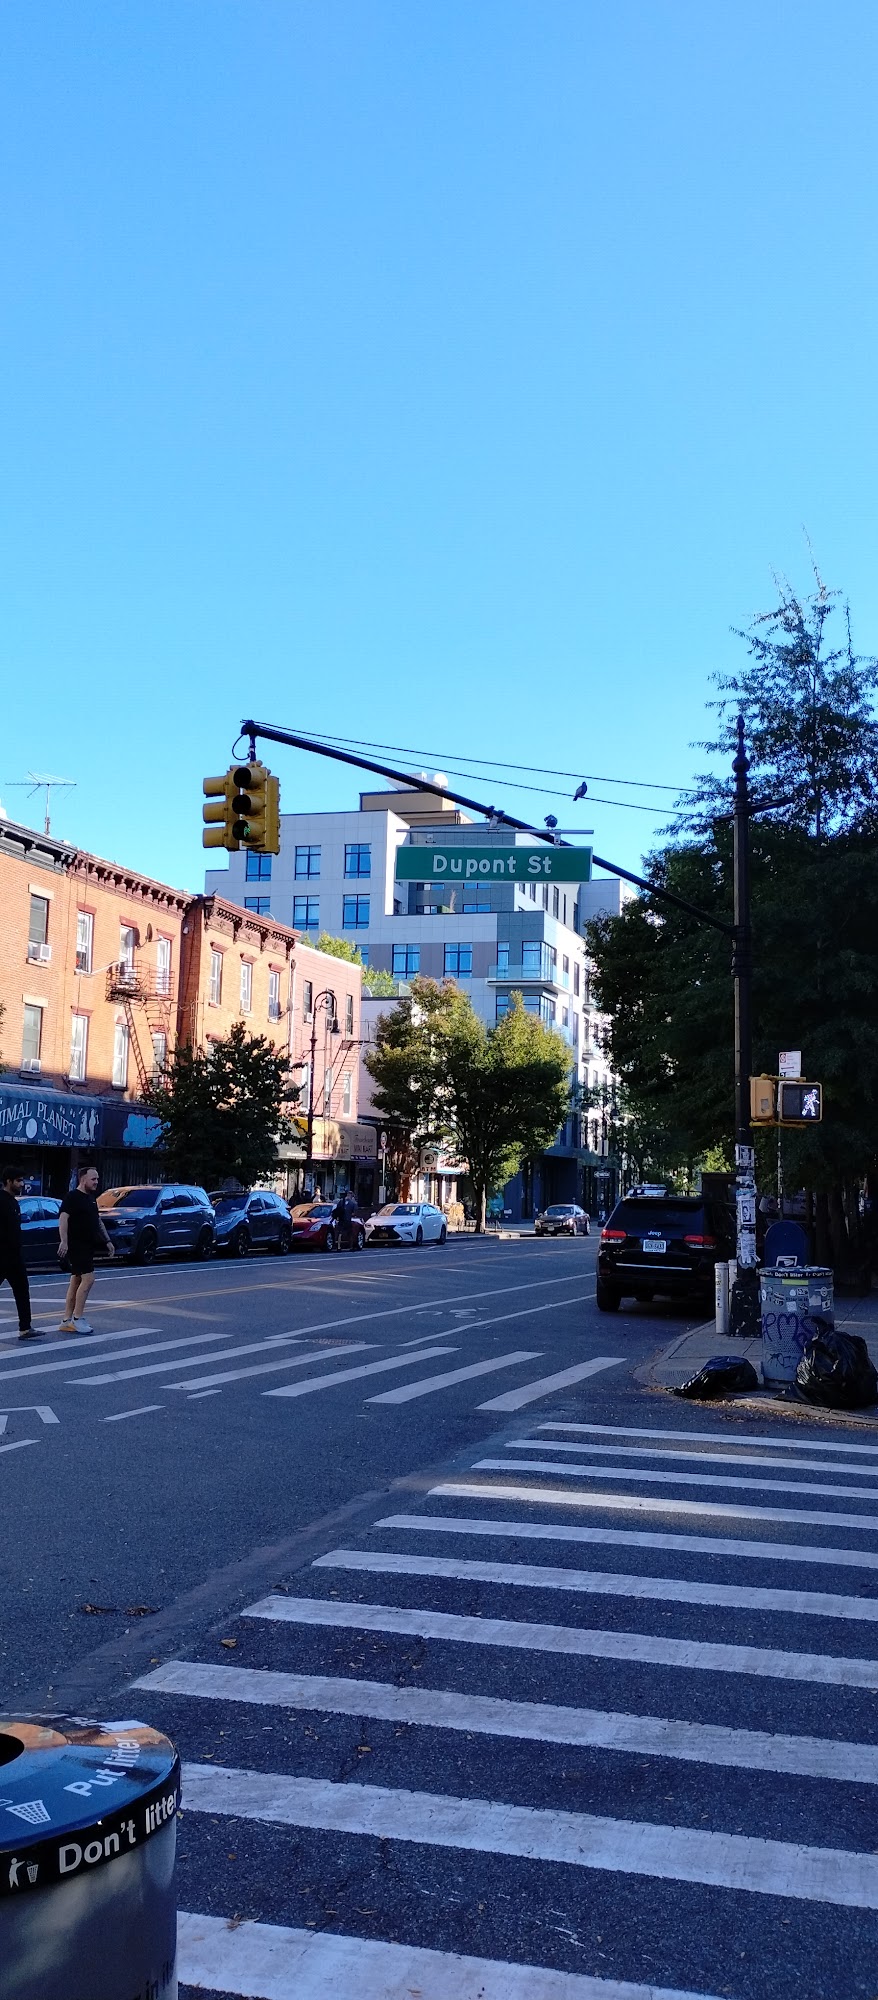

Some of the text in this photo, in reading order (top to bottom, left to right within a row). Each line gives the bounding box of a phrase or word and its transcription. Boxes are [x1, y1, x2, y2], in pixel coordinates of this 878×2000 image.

[433, 855, 552, 877] Dupont St
[37, 1101, 77, 1140] PLANET
[63, 1768, 127, 1797] Put
[102, 1737, 142, 1768] litter
[58, 1789, 178, 1874] Don't litter
